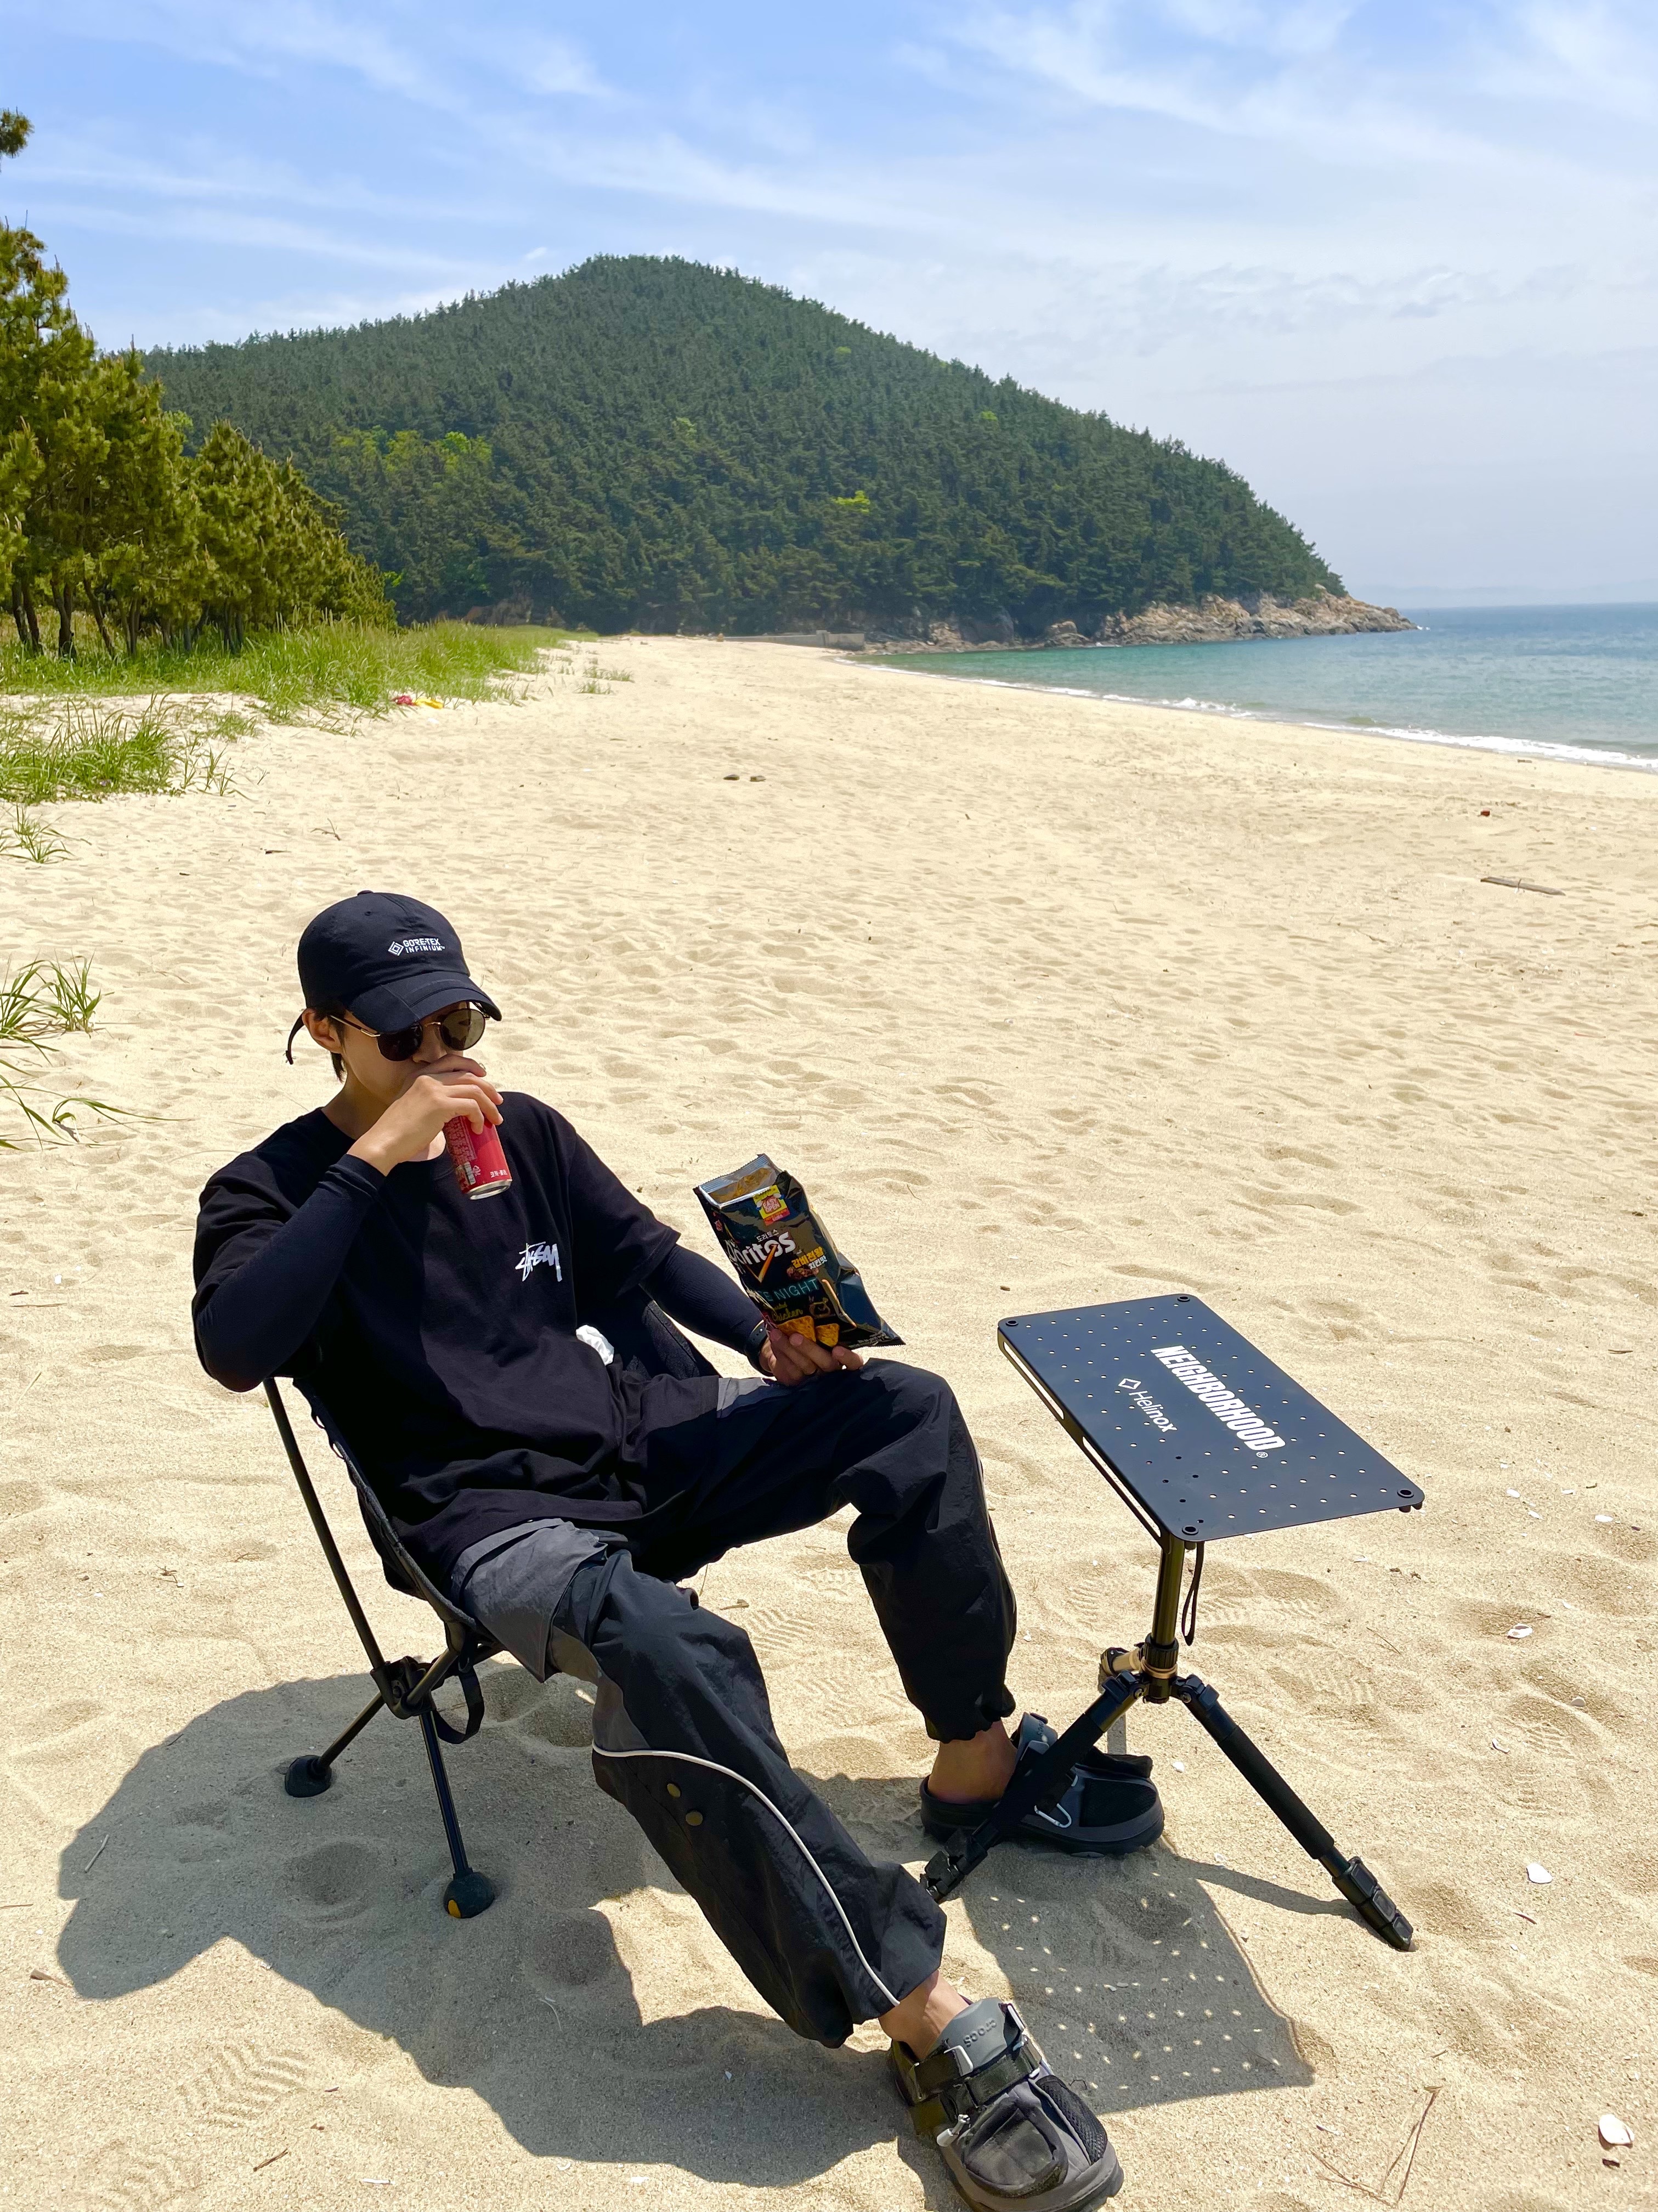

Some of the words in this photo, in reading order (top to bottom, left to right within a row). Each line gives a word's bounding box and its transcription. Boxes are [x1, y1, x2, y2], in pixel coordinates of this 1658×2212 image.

[763, 1198, 777, 1207] EASY
[765, 1202, 780, 1212] OPEN
[756, 1229, 779, 1243] 도리토스
[774, 1279, 818, 1300] NIGHT
[1129, 1390, 1178, 1432] Helinox
[963, 2018, 997, 2047] crocs
